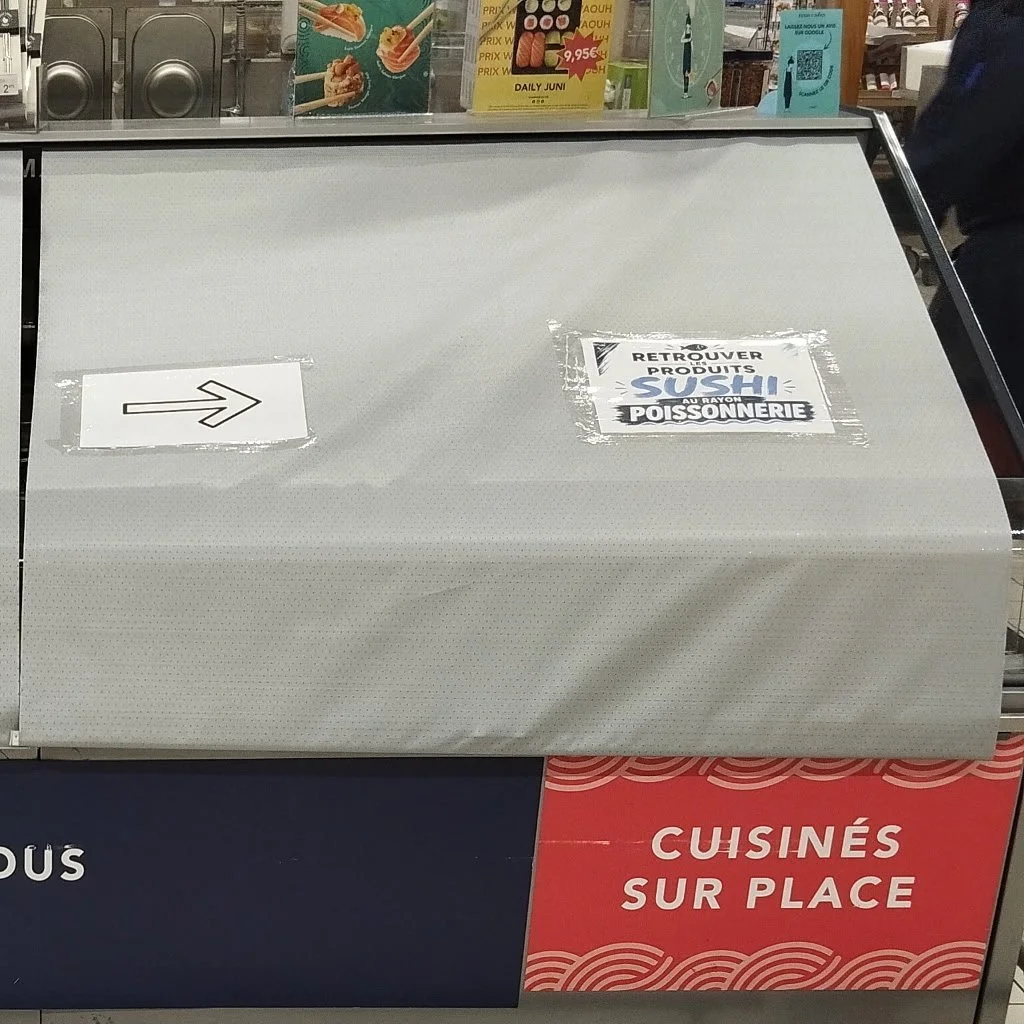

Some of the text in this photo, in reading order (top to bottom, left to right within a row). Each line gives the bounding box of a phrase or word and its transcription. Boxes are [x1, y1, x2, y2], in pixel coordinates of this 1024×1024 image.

[479, 52, 501, 61] PRIX
[563, 46, 598, 63] 9,95€
[477, 67, 499, 76] PRIX
[514, 82, 566, 92] DAILY JUNI
[631, 351, 764, 362] RETROUVER
[647, 364, 756, 376] PRODUITS
[630, 374, 779, 398] SUSHI
[629, 402, 807, 422] POISSONNERIE
[651, 817, 903, 860] CUISINÉS
[621, 875, 917, 911] SUR PLACE
